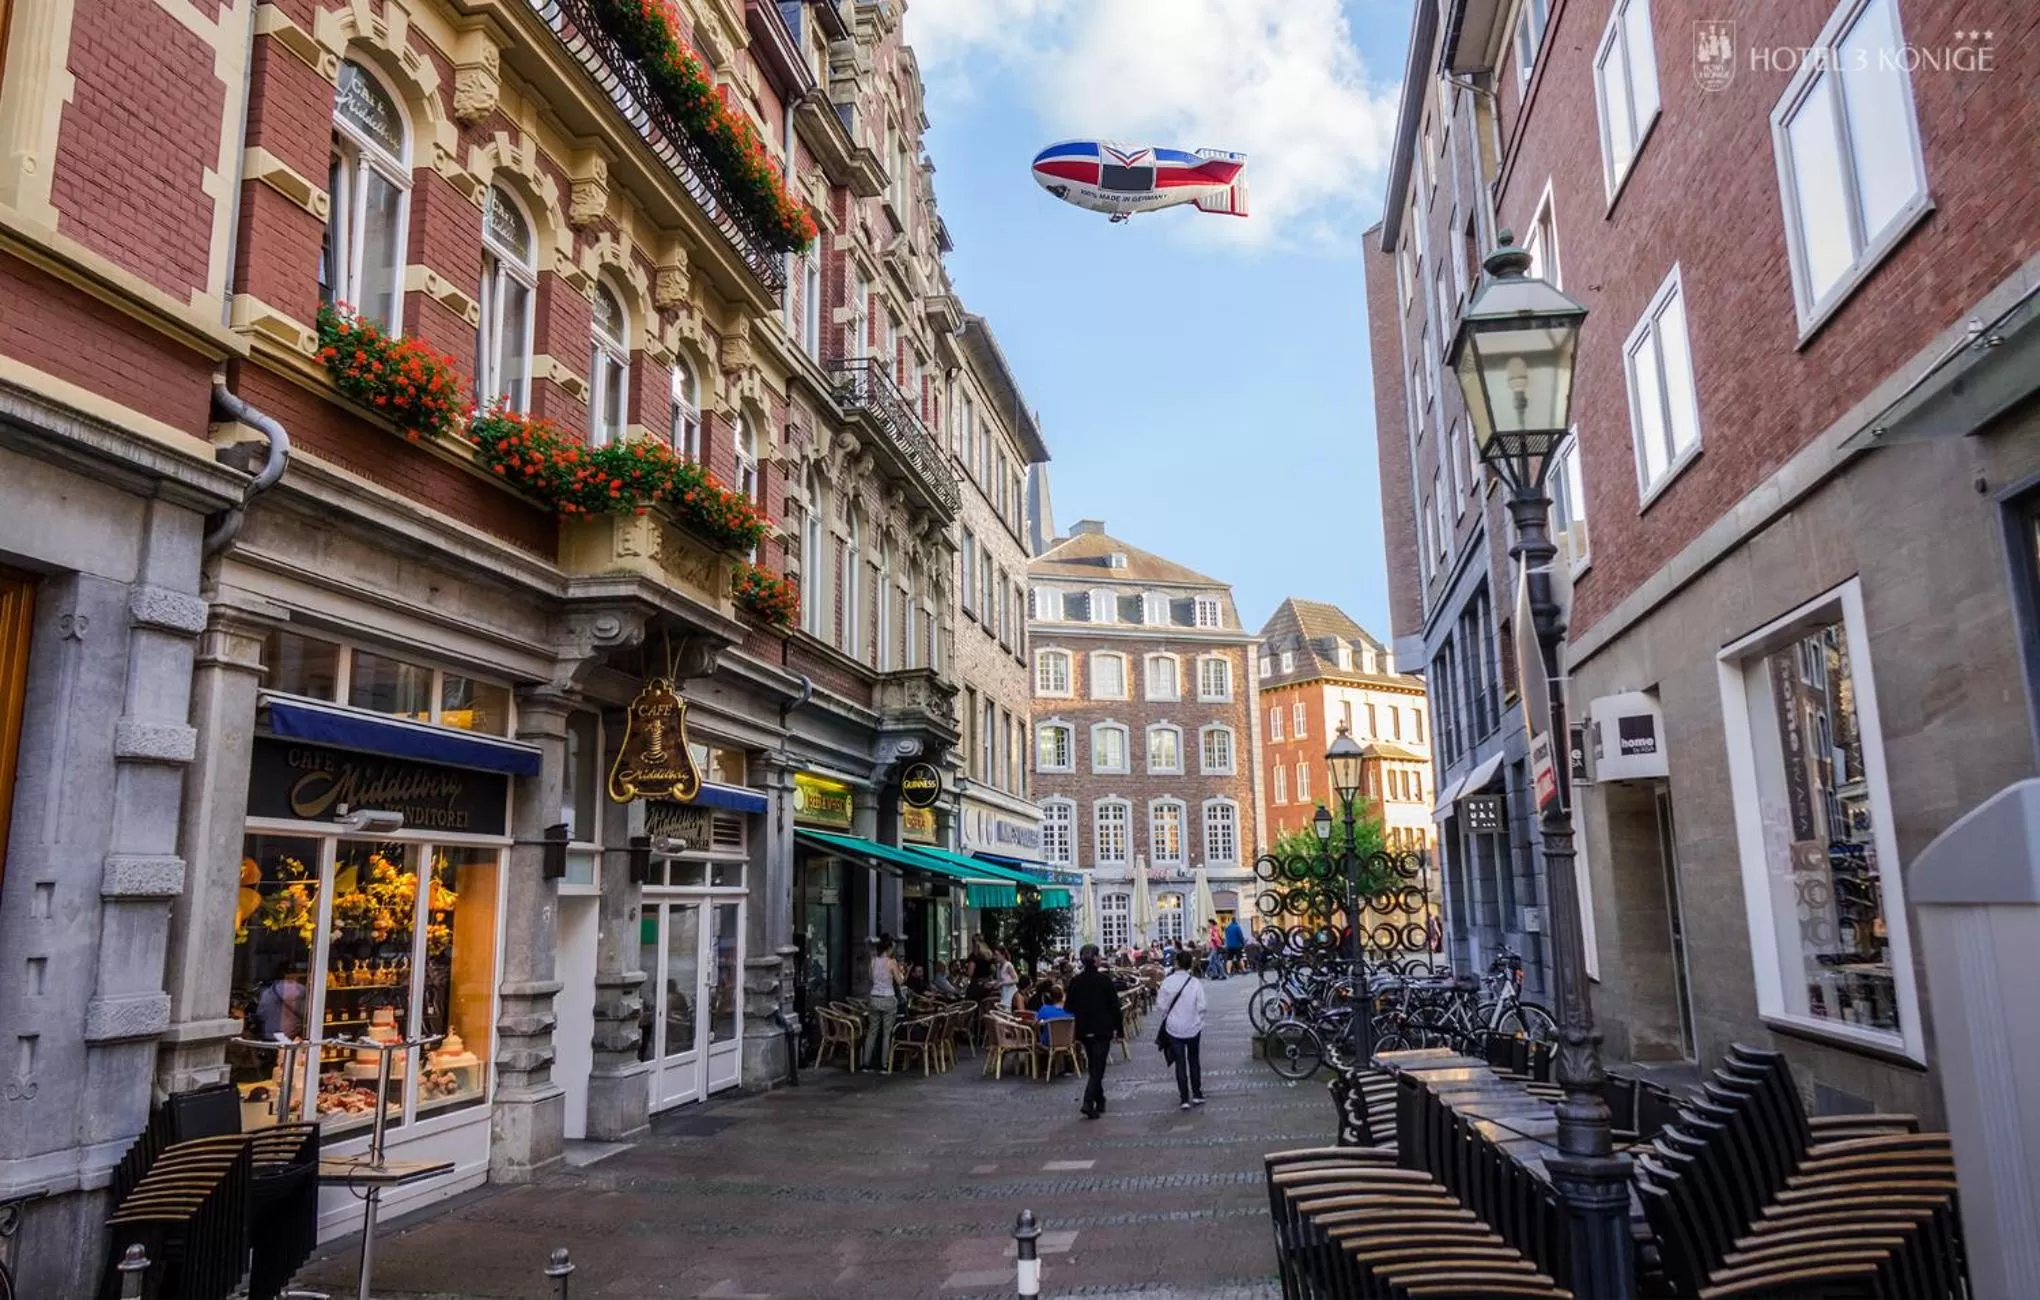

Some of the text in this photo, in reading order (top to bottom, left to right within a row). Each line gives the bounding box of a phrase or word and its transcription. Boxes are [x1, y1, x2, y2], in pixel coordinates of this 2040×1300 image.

[1099, 193, 1121, 201] MADE
[1131, 194, 1168, 202] GERMANY
[1620, 738, 1654, 748] home
[903, 779, 937, 789] GUINNESS
